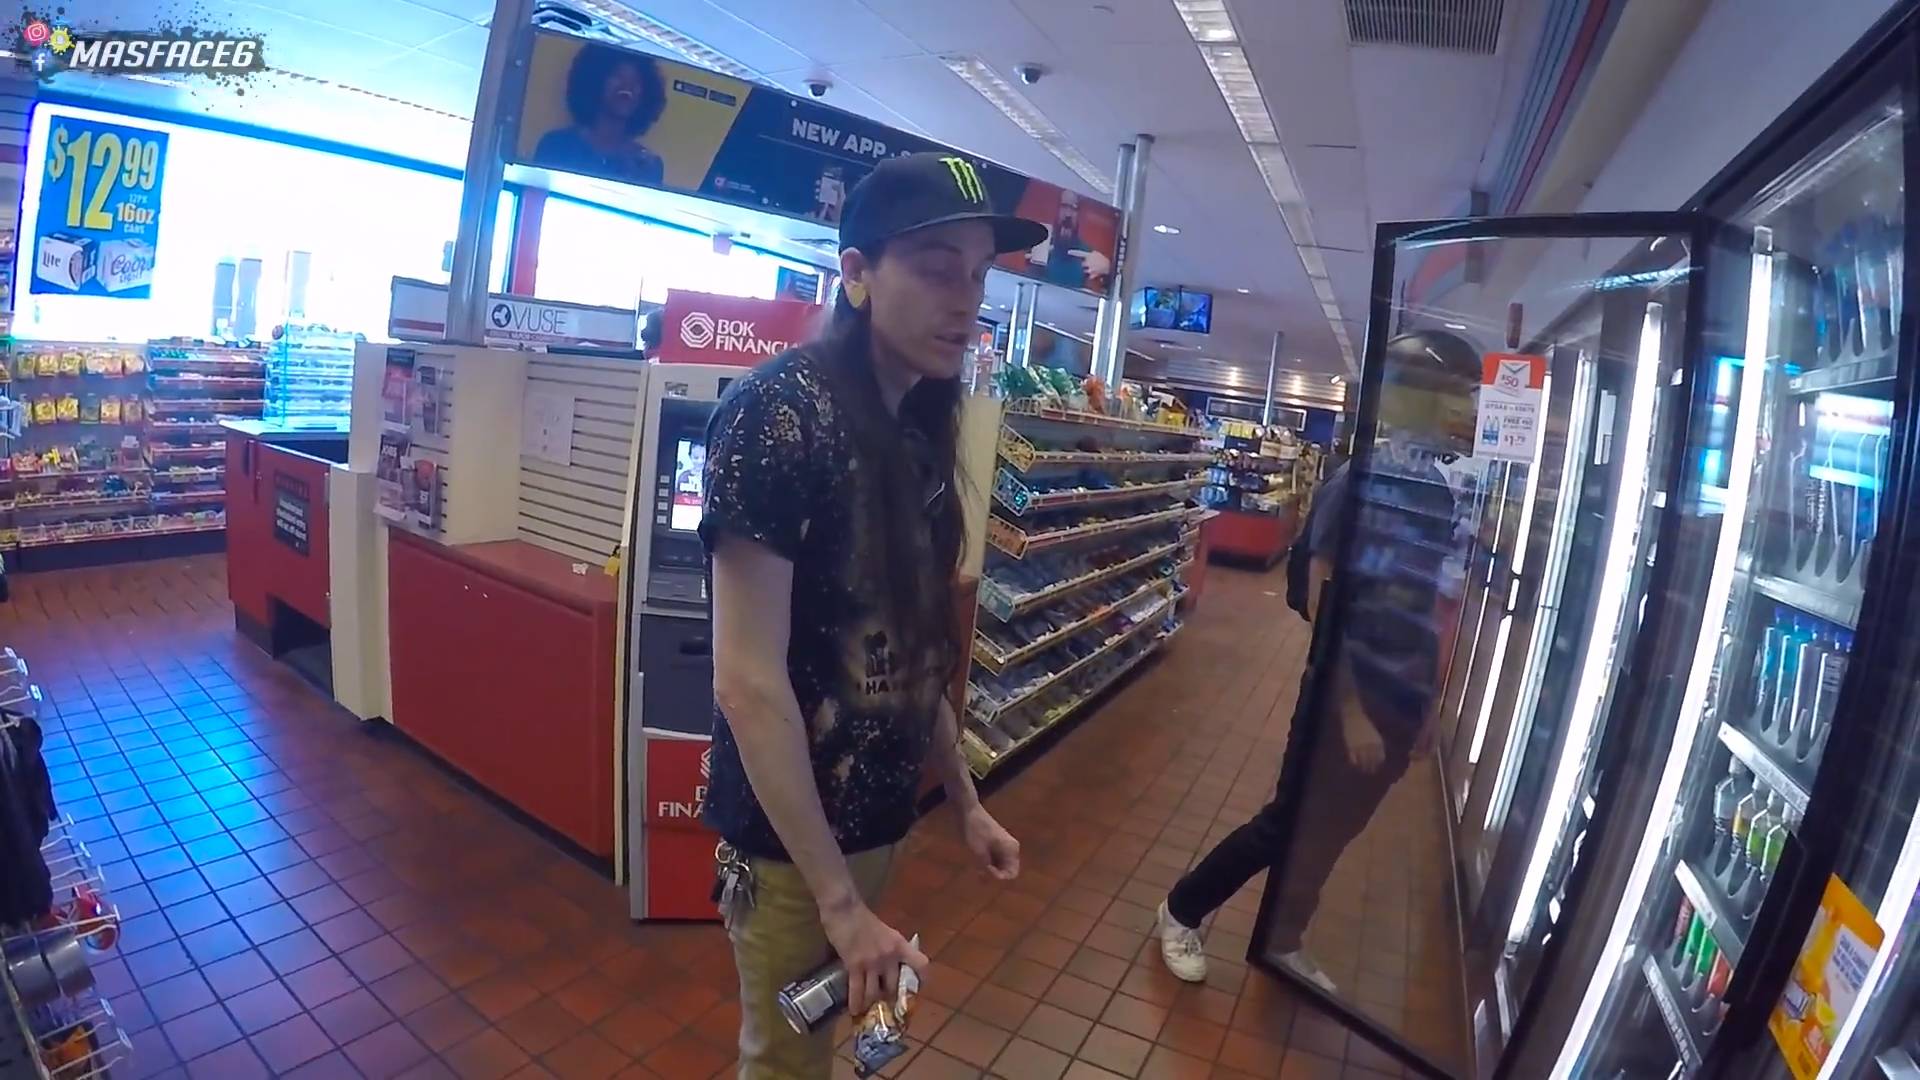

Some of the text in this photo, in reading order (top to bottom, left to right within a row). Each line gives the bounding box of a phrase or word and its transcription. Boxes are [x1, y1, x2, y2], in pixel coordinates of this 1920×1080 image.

[792, 118, 887, 158] NEW APP
[512, 304, 569, 335] VUSE
[717, 319, 755, 337] BOK
[715, 335, 802, 356] FINANCI
